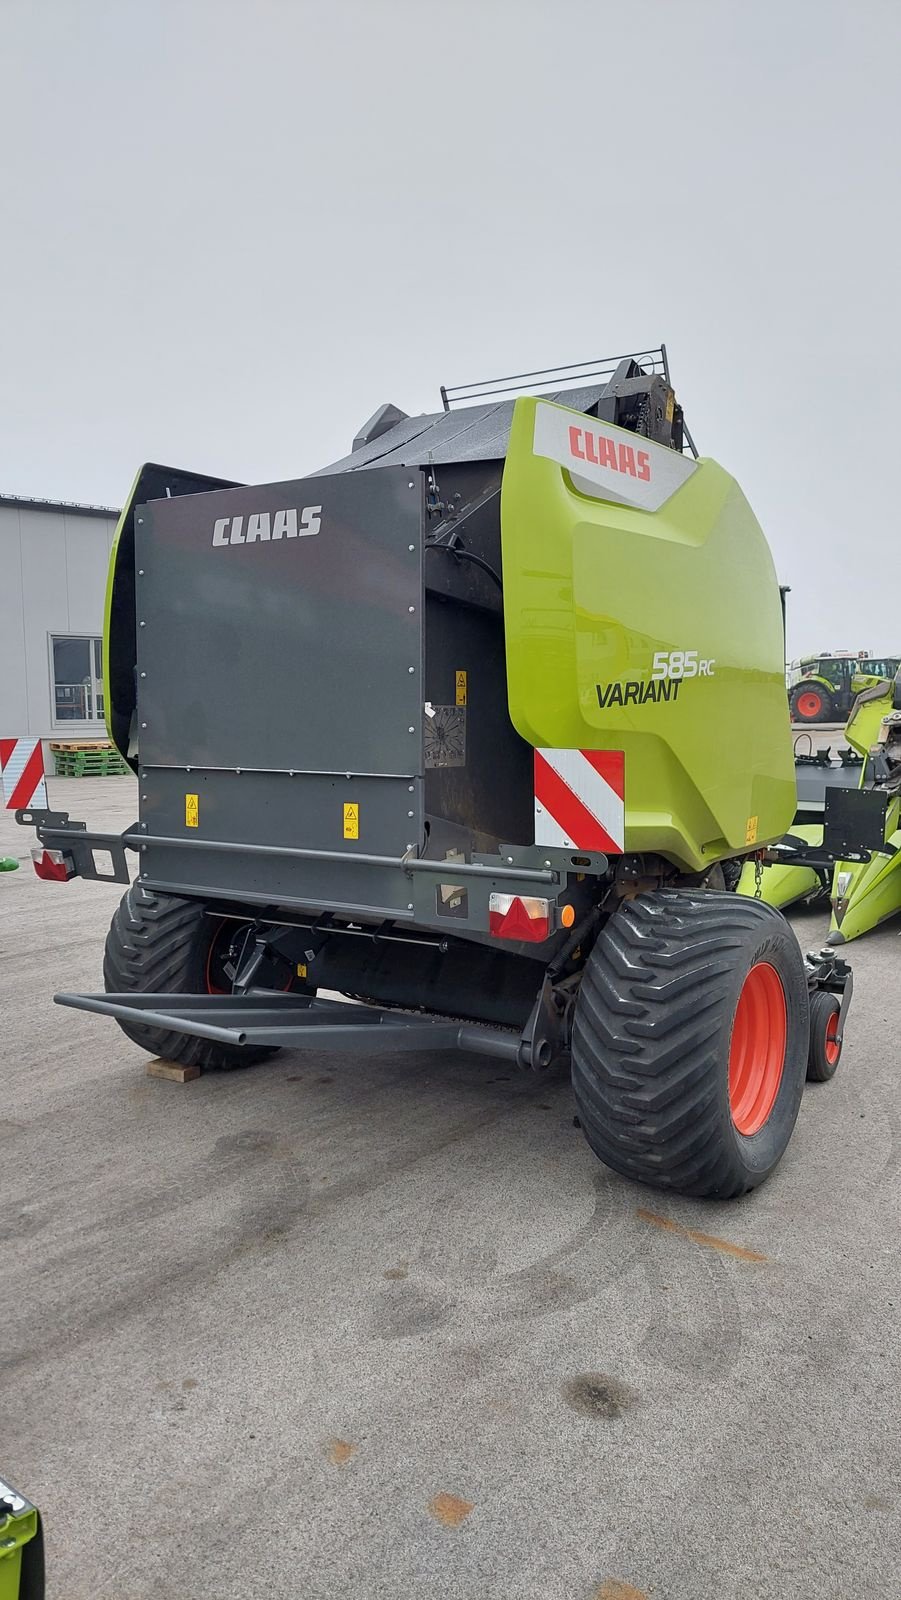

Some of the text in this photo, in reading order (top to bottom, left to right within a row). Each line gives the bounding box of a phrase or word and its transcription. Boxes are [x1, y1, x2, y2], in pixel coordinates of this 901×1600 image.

[568, 426, 651, 482] CLAAS
[212, 505, 322, 547] CLAAS
[595, 678, 683, 709] VARIANT
